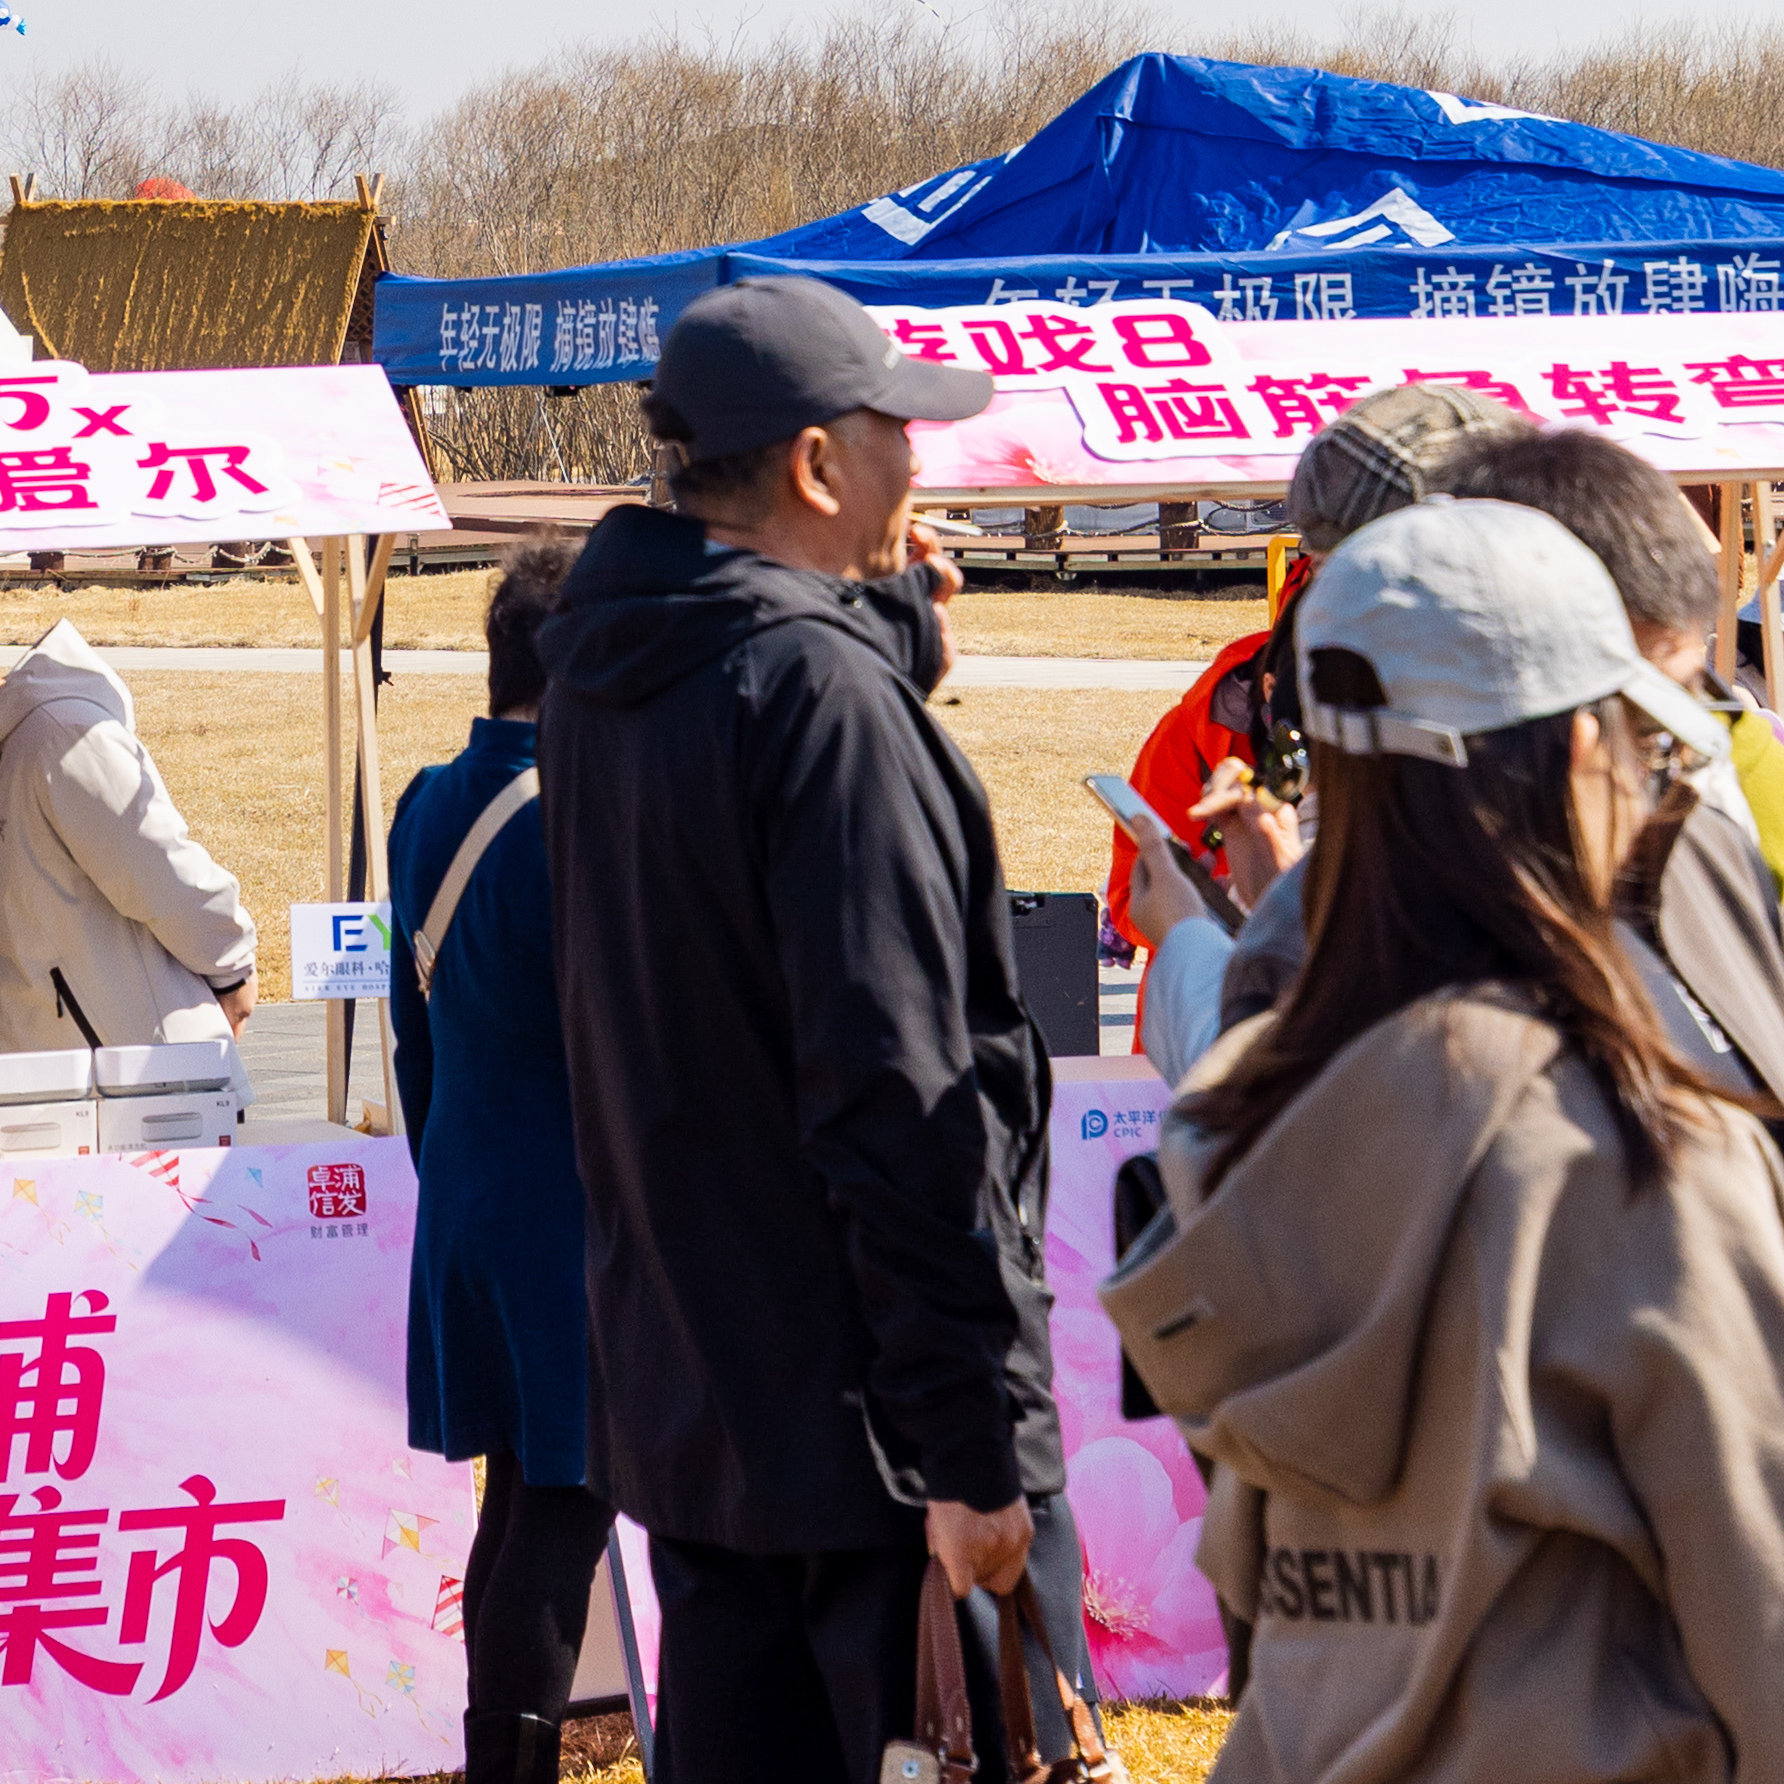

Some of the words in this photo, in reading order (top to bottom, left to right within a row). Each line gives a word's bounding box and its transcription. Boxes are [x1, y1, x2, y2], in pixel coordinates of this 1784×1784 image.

[439, 301, 543, 372] 年轻无极限
[1113, 1127, 1143, 1139] CPIC
[310, 1223, 370, 1240] 财富管理
